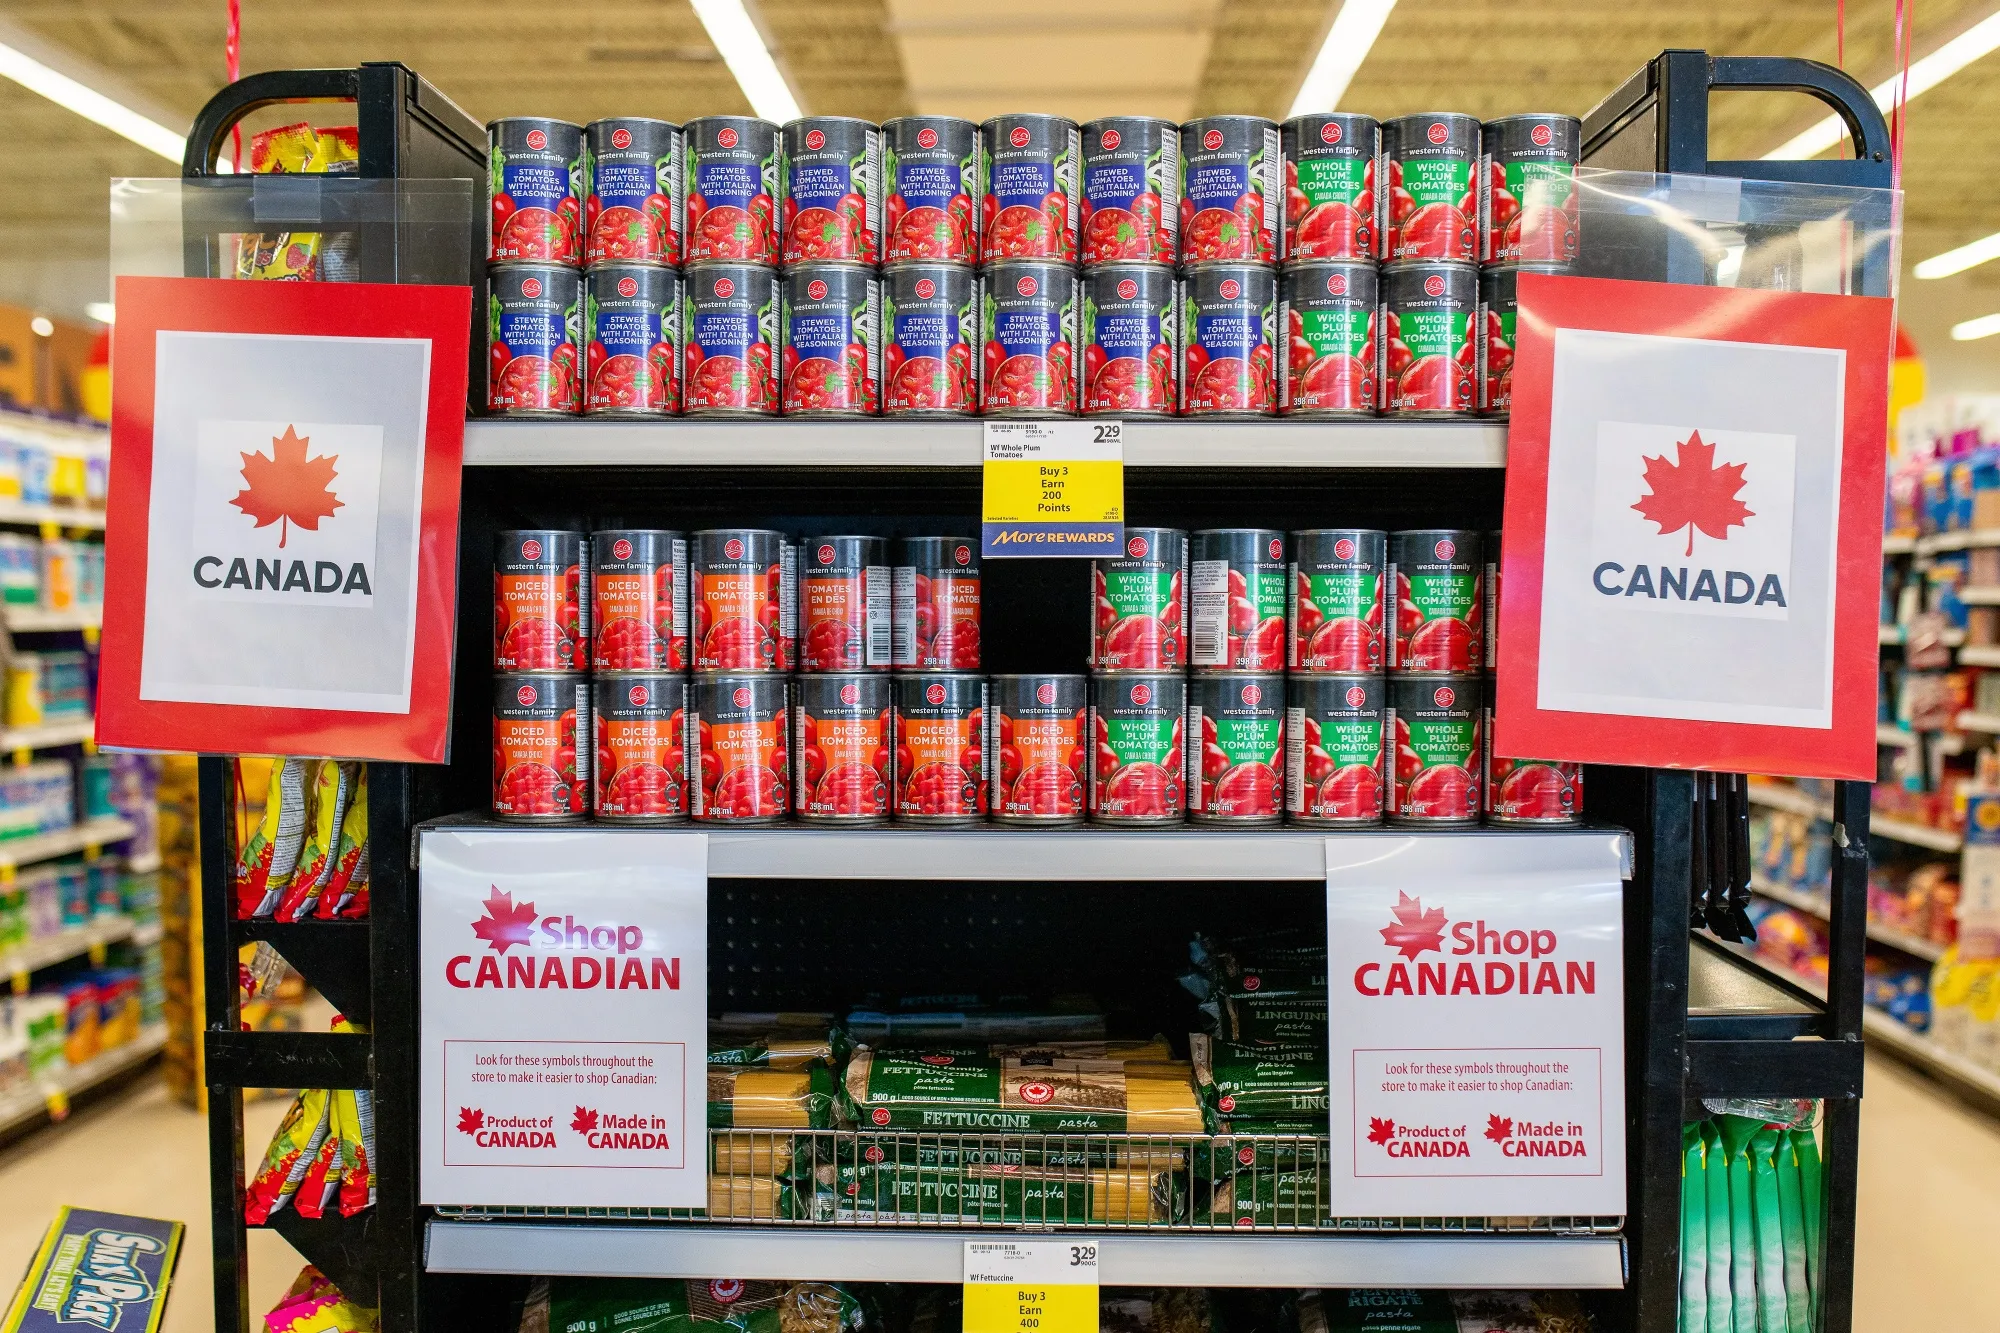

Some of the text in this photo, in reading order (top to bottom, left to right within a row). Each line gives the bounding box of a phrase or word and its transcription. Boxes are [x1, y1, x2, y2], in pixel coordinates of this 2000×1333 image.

[1304, 146, 1360, 157] western family
[509, 152, 565, 163] western family
[519, 168, 555, 177] STEWED
[1310, 162, 1352, 173] WHOLE
[514, 175, 560, 185] TOMATOES
[1316, 172, 1347, 181] PLUM
[531, 183, 565, 192] ITALIAN
[1302, 181, 1360, 191] TOMATOES
[512, 190, 561, 199] SEASONING
[496, 248, 507, 257] 398
[1290, 248, 1301, 256] 398
[1040, 467, 1068, 478] Buy 3
[1042, 480, 1065, 488] Earn
[1043, 491, 1061, 500] 200
[1038, 504, 1071, 512] Points
[992, 531, 1115, 545] More REWARDS
[194, 556, 372, 596] CANADA
[808, 585, 852, 593] TOMATES
[1593, 561, 1789, 607] CANADA
[811, 596, 823, 604] EN
[911, 707, 964, 717] western family
[1416, 709, 1470, 719] western family
[920, 726, 953, 735] DICED
[1424, 725, 1464, 734] WHOLE
[908, 735, 967, 745] TOMATOES
[1429, 734, 1459, 743] PLUM
[1414, 742, 1471, 752] TOMATOES
[1400, 805, 1412, 813] 398
[541, 916, 644, 955] Shop
[1451, 920, 1557, 959] Shop
[446, 956, 681, 990] CANADIAN
[1354, 961, 1596, 997] CANADIAN
[1275, 1022, 1313, 1031] pasta
[1235, 1050, 1314, 1061] LINGUINE
[476, 1054, 654, 1070] Look for these symbols throughout the
[889, 1058, 941, 1069] western
[1255, 1062, 1295, 1071] pasta
[883, 1067, 988, 1078] FETTUCCINE
[1386, 1062, 1569, 1077] Look for these symbols throughout the
[472, 1072, 657, 1086] store to make it easier to shop Canadian:
[914, 1077, 955, 1085] pasta
[1382, 1079, 1573, 1093] store to make it easier to shop Canadian:
[872, 1093, 888, 1101] 900
[487, 1116, 553, 1128] Product of
[603, 1114, 666, 1130] Made in
[923, 1111, 1031, 1128] FETTUCCINE
[1057, 1116, 1098, 1130] pasta
[1399, 1125, 1466, 1138] Product of
[1518, 1122, 1583, 1137] Made in
[476, 1132, 557, 1148] CANADA
[587, 1133, 669, 1150] CANADA
[1387, 1141, 1471, 1158] CANADA
[1502, 1140, 1587, 1157] CANADA
[1237, 1200, 1253, 1210] 900
[970, 1274, 1014, 1282] Wf Fettuccine
[1018, 1291, 1046, 1303] Buy 3
[1348, 1296, 1424, 1307] RIGATE
[1020, 1306, 1042, 1315] Earn
[1365, 1308, 1414, 1321] pasta
[567, 1321, 596, 1333] 900 g
[1020, 1319, 1039, 1328] 400
